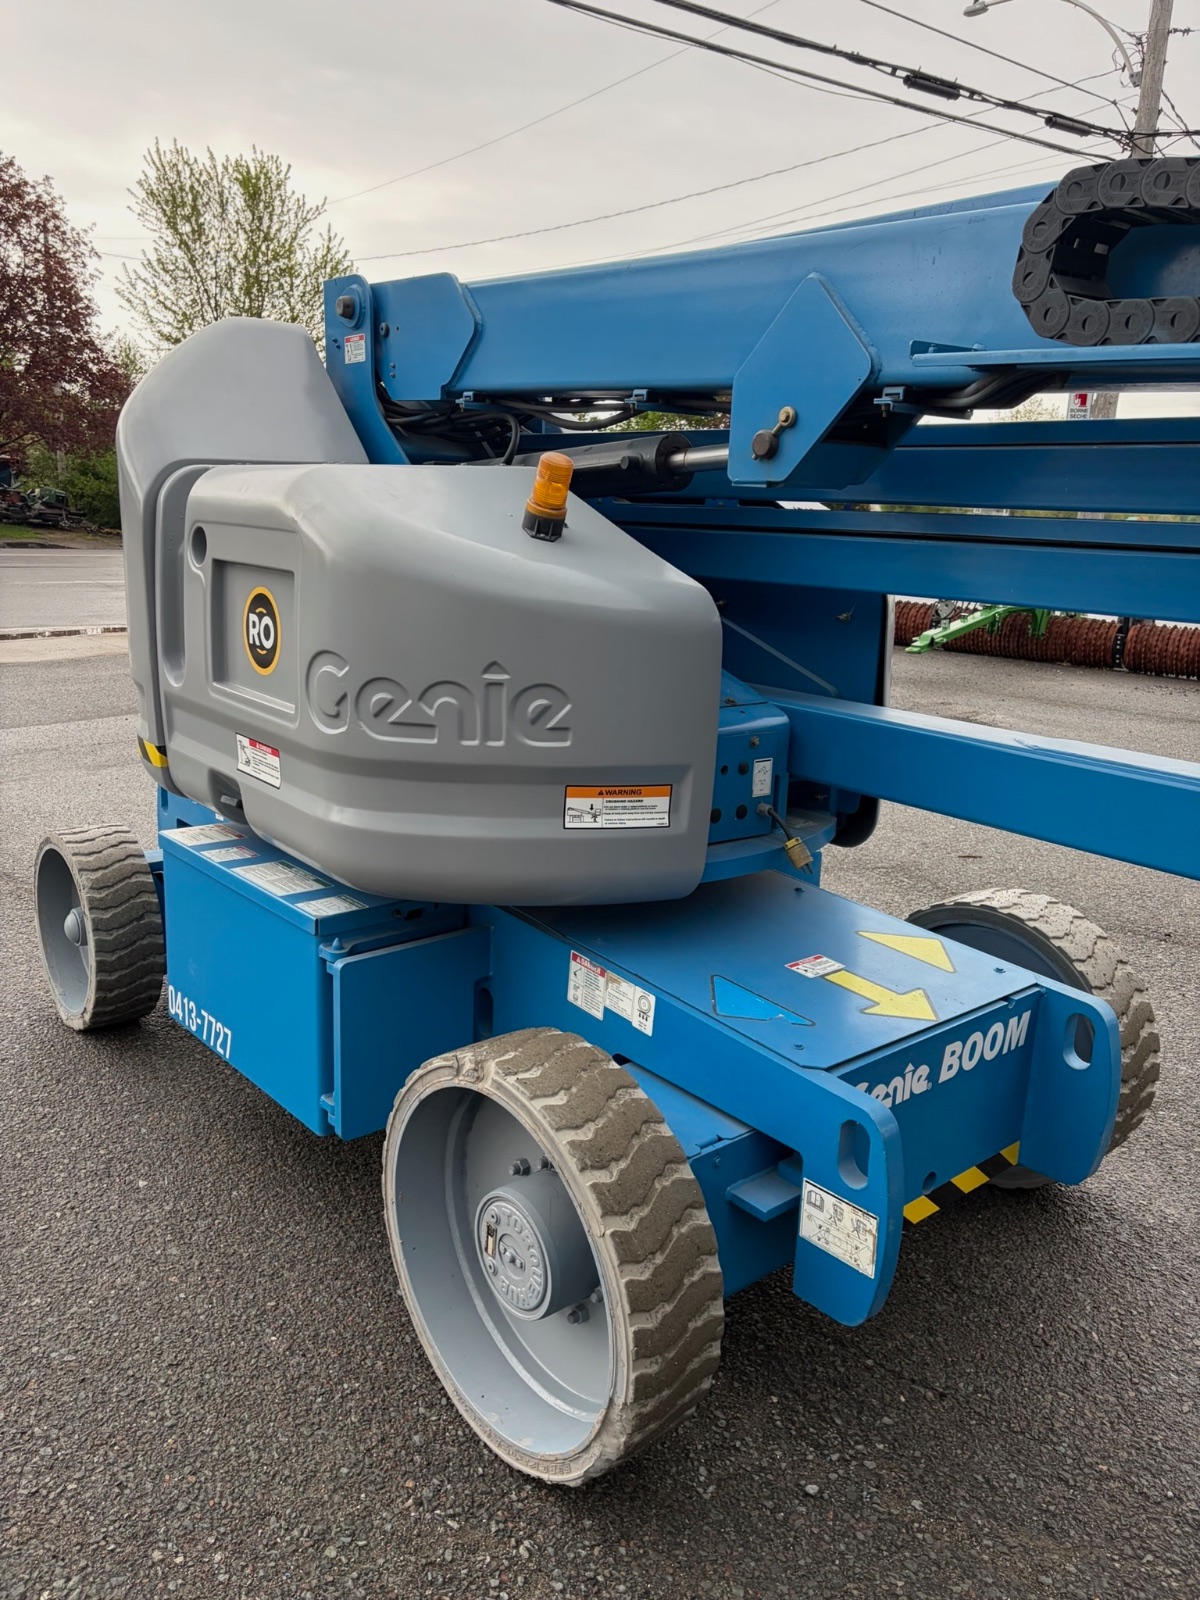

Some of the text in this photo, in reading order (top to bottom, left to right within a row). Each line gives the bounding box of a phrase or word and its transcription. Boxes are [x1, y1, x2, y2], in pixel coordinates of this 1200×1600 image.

[248, 612, 275, 650] RO
[305, 649, 573, 747] Genie
[605, 788, 642, 796] WARNING
[167, 984, 232, 1059] 0413-7727
[938, 1010, 1032, 1084] BOOM
[501, 1207, 544, 1300] TORQUE
